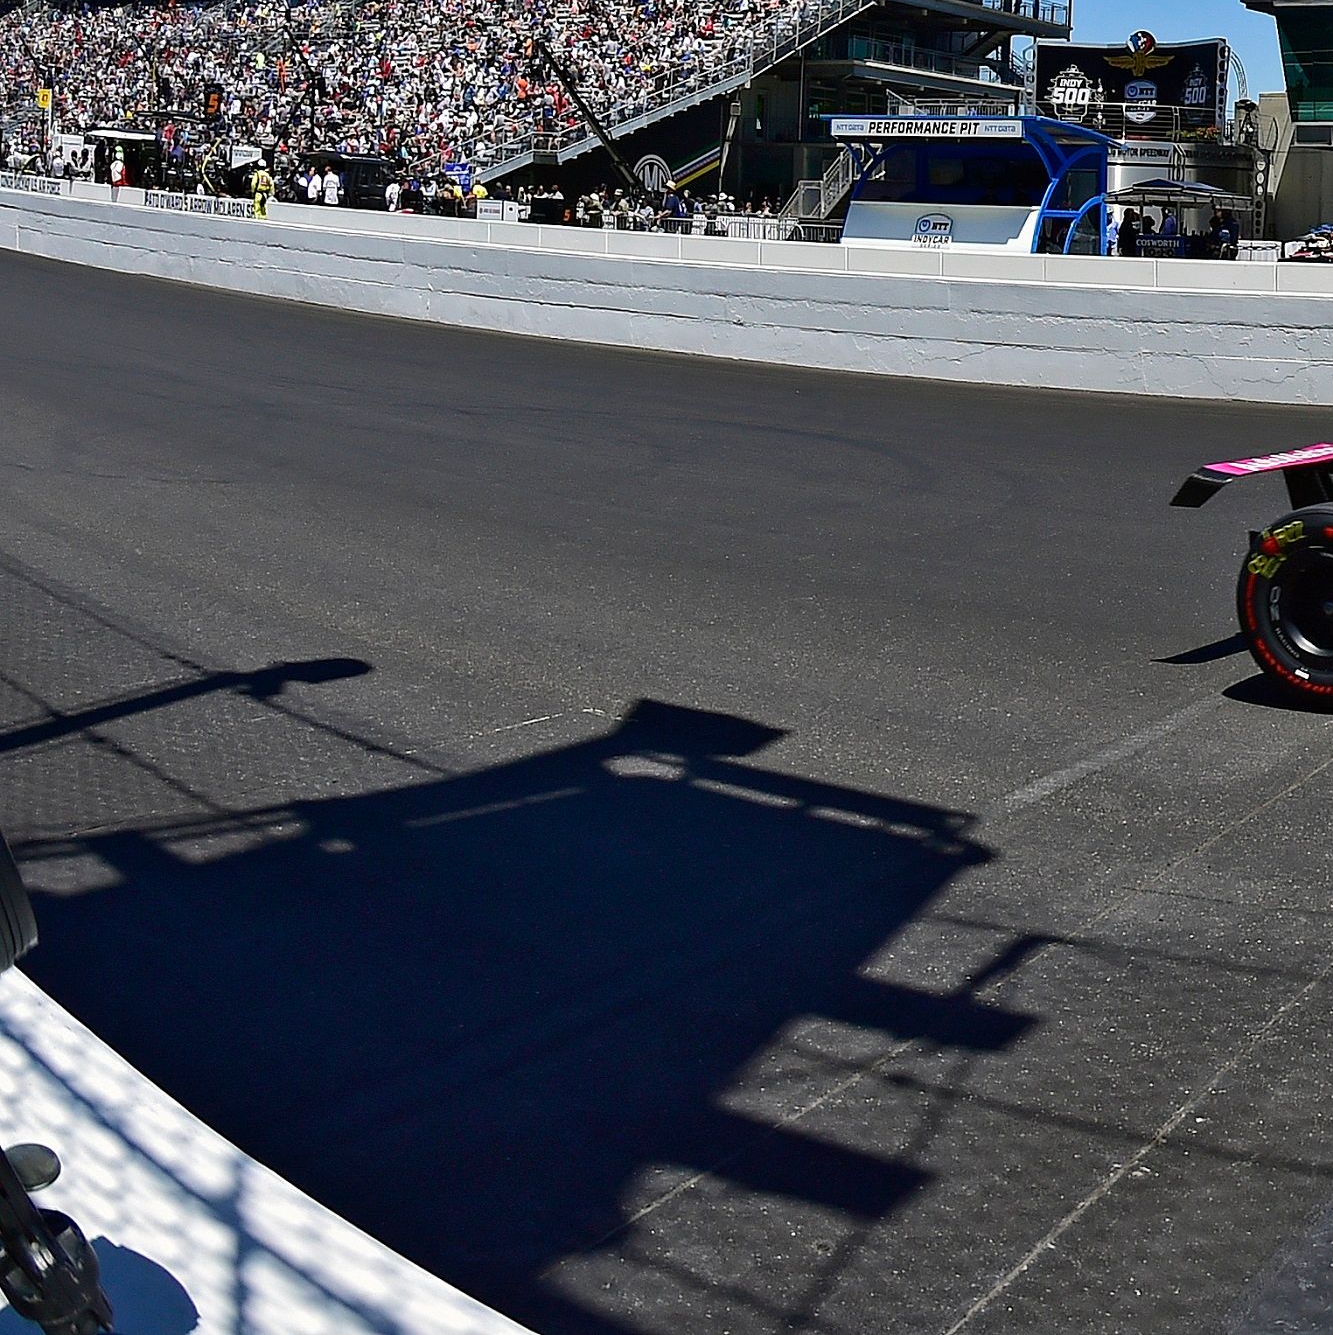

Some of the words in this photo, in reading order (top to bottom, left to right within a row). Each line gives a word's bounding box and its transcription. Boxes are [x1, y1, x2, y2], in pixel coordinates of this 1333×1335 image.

[1059, 79, 1084, 88] INDY
[1052, 87, 1091, 105] 500
[1184, 87, 1207, 105] 500
[207, 93, 220, 114] 5
[868, 121, 956, 135] PERFORMANCE
[959, 122, 980, 135] PIT
[912, 234, 950, 245] INDYCAR
[1135, 239, 1180, 248] COSWORTH
